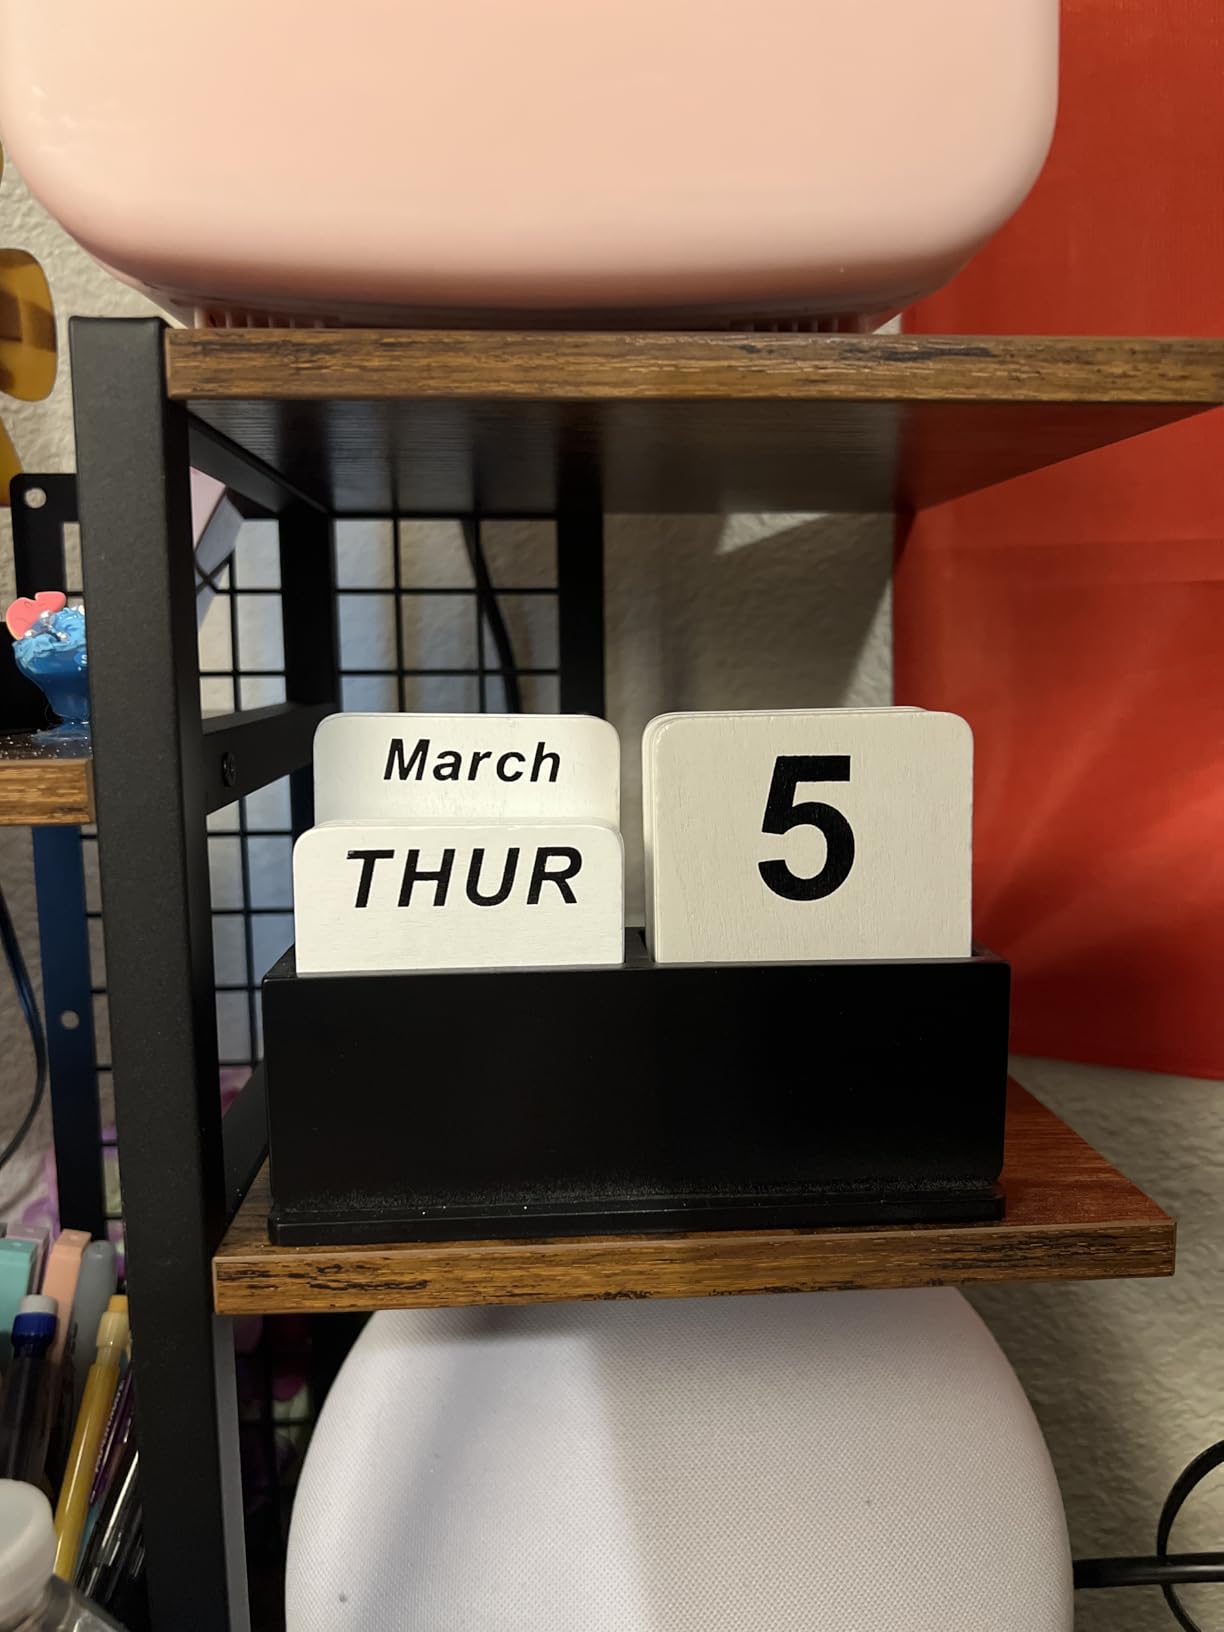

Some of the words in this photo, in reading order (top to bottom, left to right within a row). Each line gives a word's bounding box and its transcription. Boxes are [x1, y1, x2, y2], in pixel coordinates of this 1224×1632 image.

[383, 738, 561, 783] March
[757, 754, 856, 902] 5
[346, 846, 583, 909] THUR
